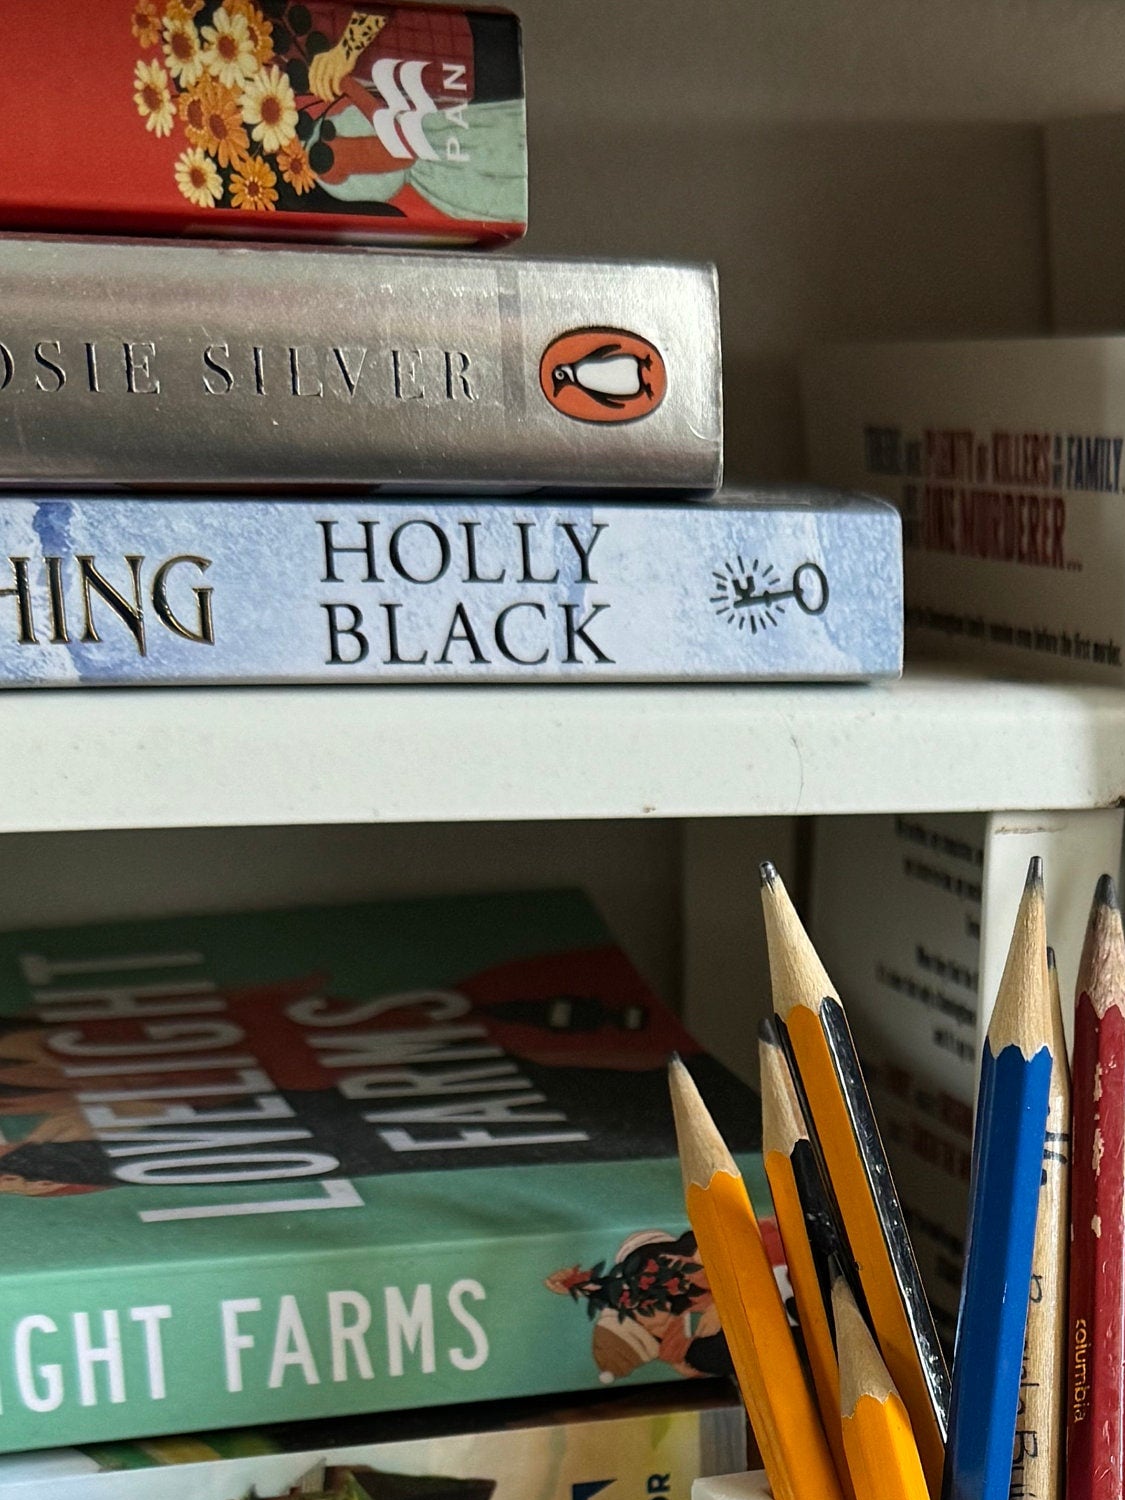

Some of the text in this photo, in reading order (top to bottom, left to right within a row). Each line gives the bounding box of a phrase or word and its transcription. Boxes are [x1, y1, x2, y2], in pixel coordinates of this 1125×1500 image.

[442, 63, 471, 163] PAN
[202, 343, 478, 400] SILVER
[316, 518, 610, 586] HOLLY
[323, 601, 617, 666] BLACK
[18, 950, 365, 1223] LOVELIGHT
[284, 988, 591, 1153] FARMS
[0, 1278, 490, 1414] GHT FARMS
[1072, 1317, 1090, 1424] columbia
